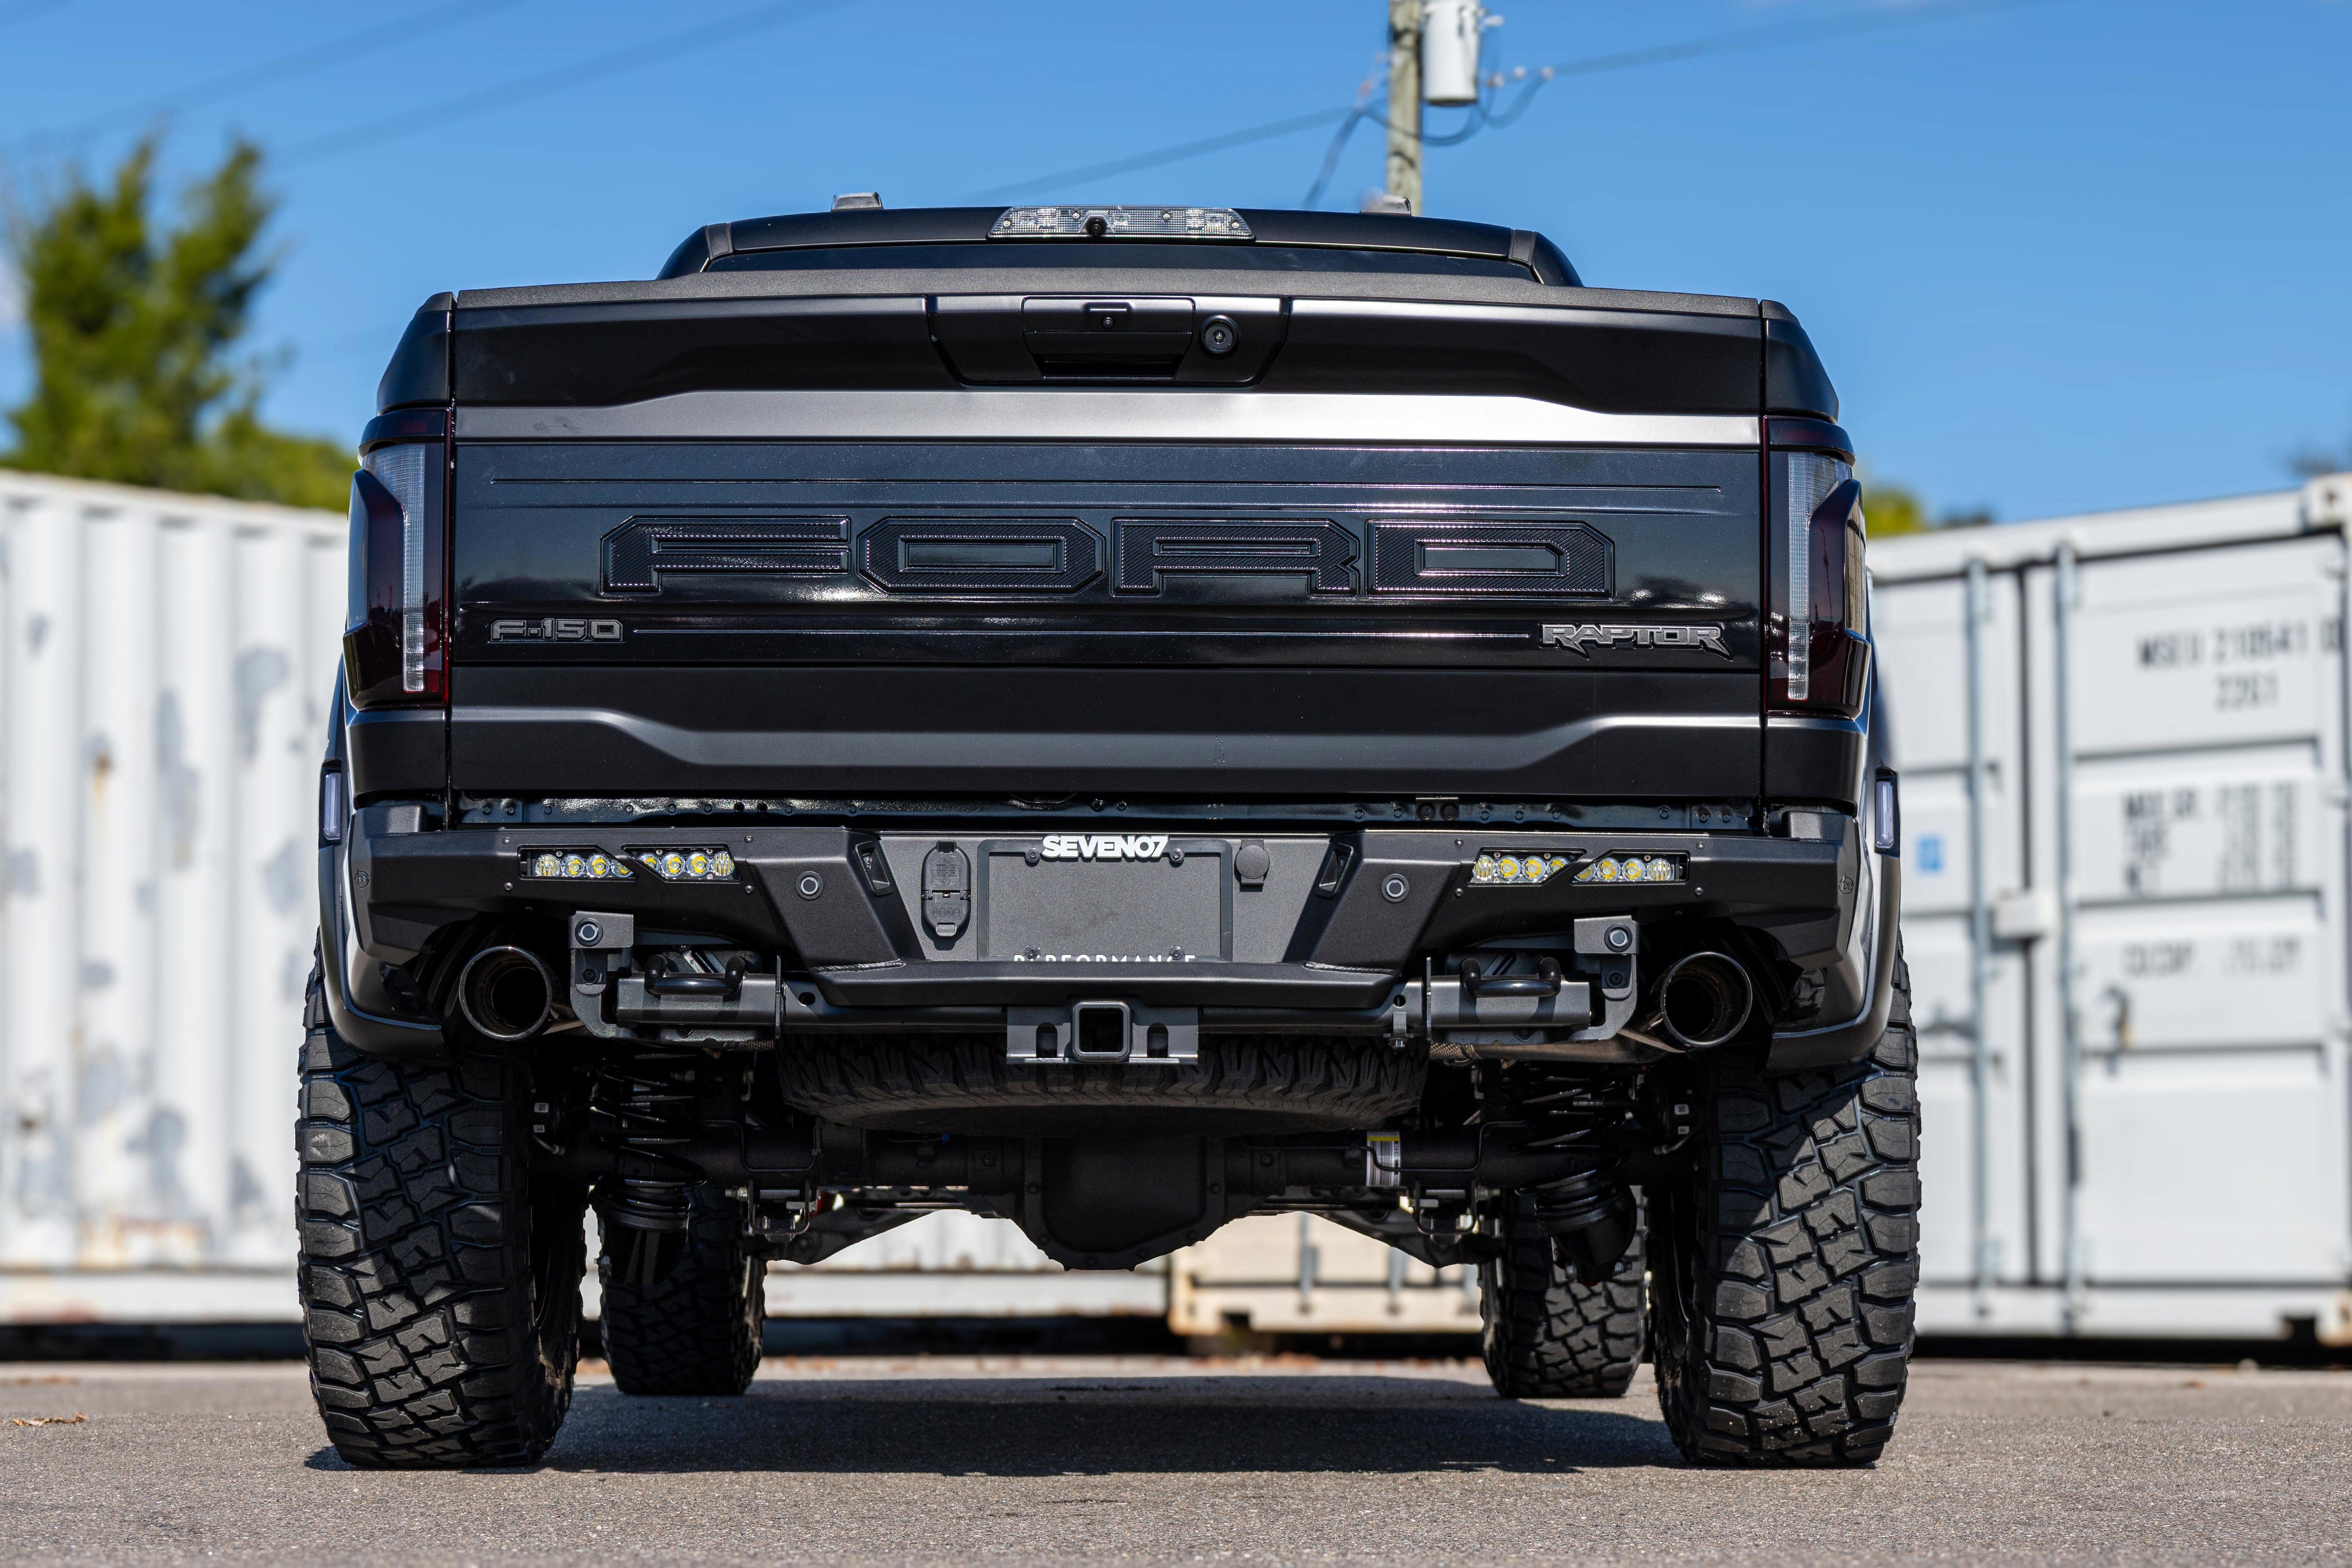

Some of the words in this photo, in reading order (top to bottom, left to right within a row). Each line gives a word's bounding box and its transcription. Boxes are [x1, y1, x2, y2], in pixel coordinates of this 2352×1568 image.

[600, 515, 1614, 599] FORD
[491, 618, 623, 641] F-150
[1539, 624, 1733, 661] RAPTOR
